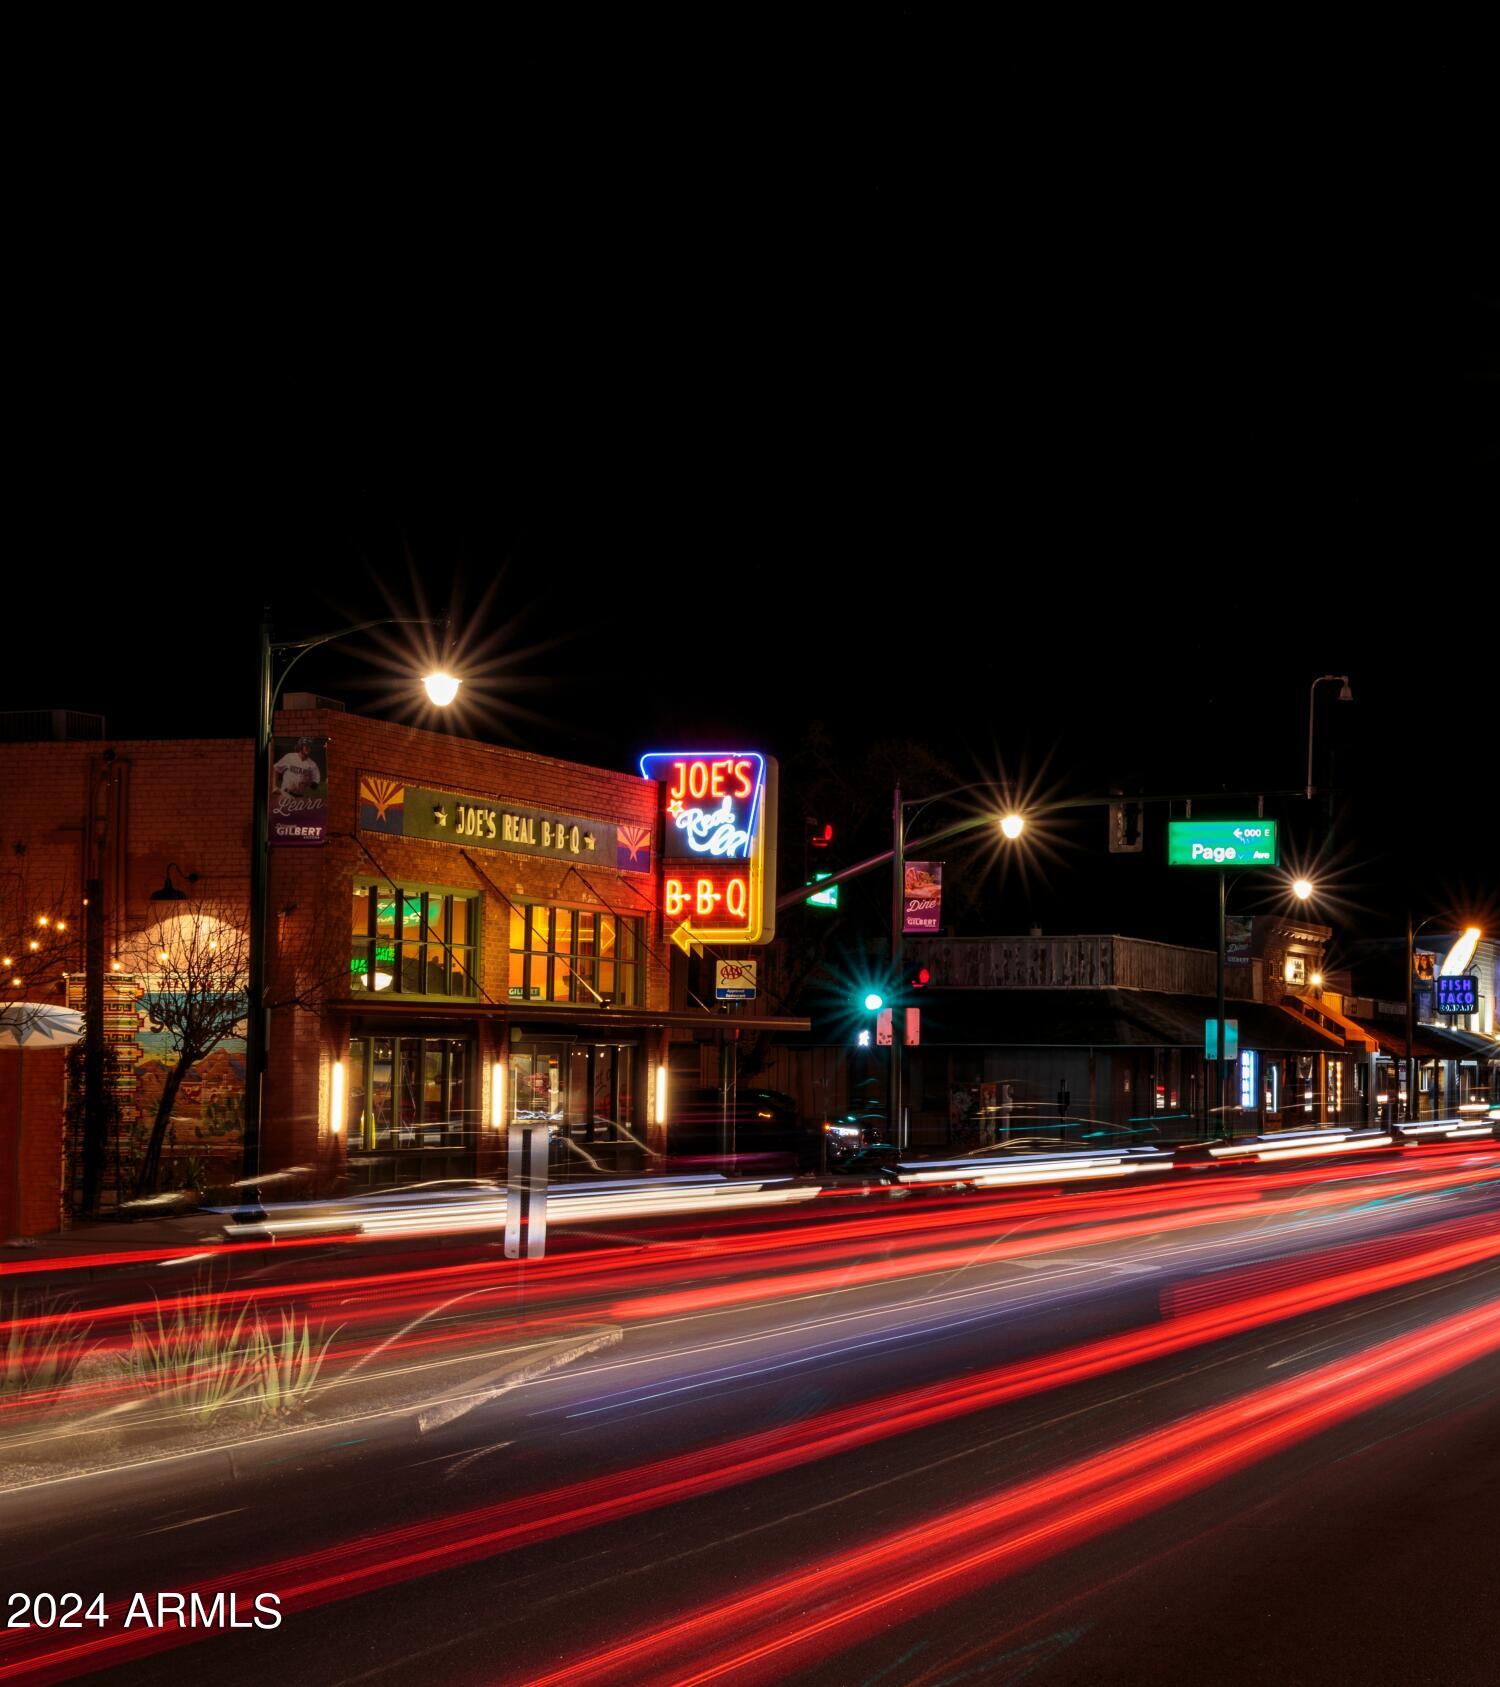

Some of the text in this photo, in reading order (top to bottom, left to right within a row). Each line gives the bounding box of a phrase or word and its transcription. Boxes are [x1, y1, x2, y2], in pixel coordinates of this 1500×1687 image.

[671, 760, 752, 798] JOE'S
[272, 798, 323, 816] Learn
[276, 827, 322, 836] GILBERT
[455, 806, 497, 839] JOE'S
[502, 814, 536, 845] REAL
[1264, 829, 1270, 837] E
[1192, 843, 1270, 862] Page Ave
[906, 899, 937, 913] Dine
[1441, 979, 1471, 991] FISH
[1439, 992, 1474, 1004] TACO
